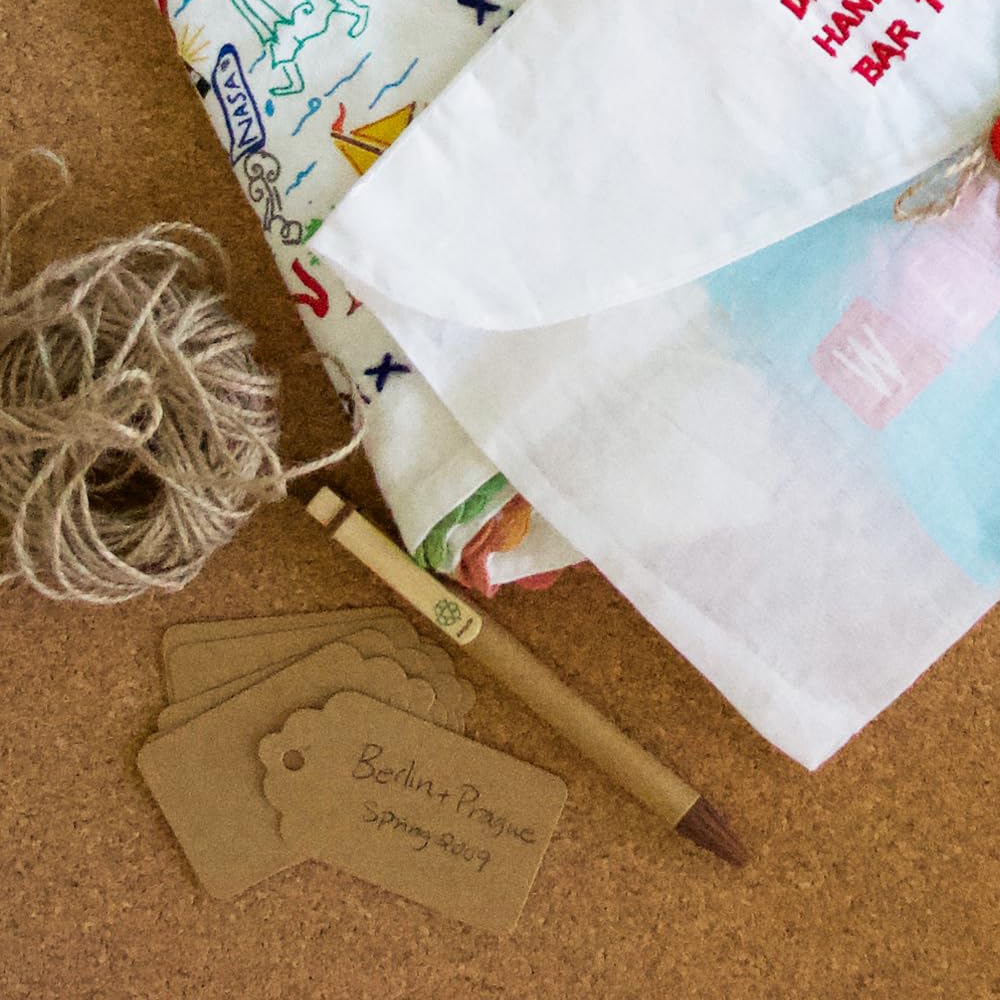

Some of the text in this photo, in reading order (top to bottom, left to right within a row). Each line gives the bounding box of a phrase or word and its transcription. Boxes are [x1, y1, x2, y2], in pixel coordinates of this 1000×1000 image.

[851, 18, 921, 87] BAR
[224, 72, 258, 148] NASA
[352, 742, 433, 798] Berlin
[456, 784, 537, 844] Prague
[362, 801, 431, 851] Spring
